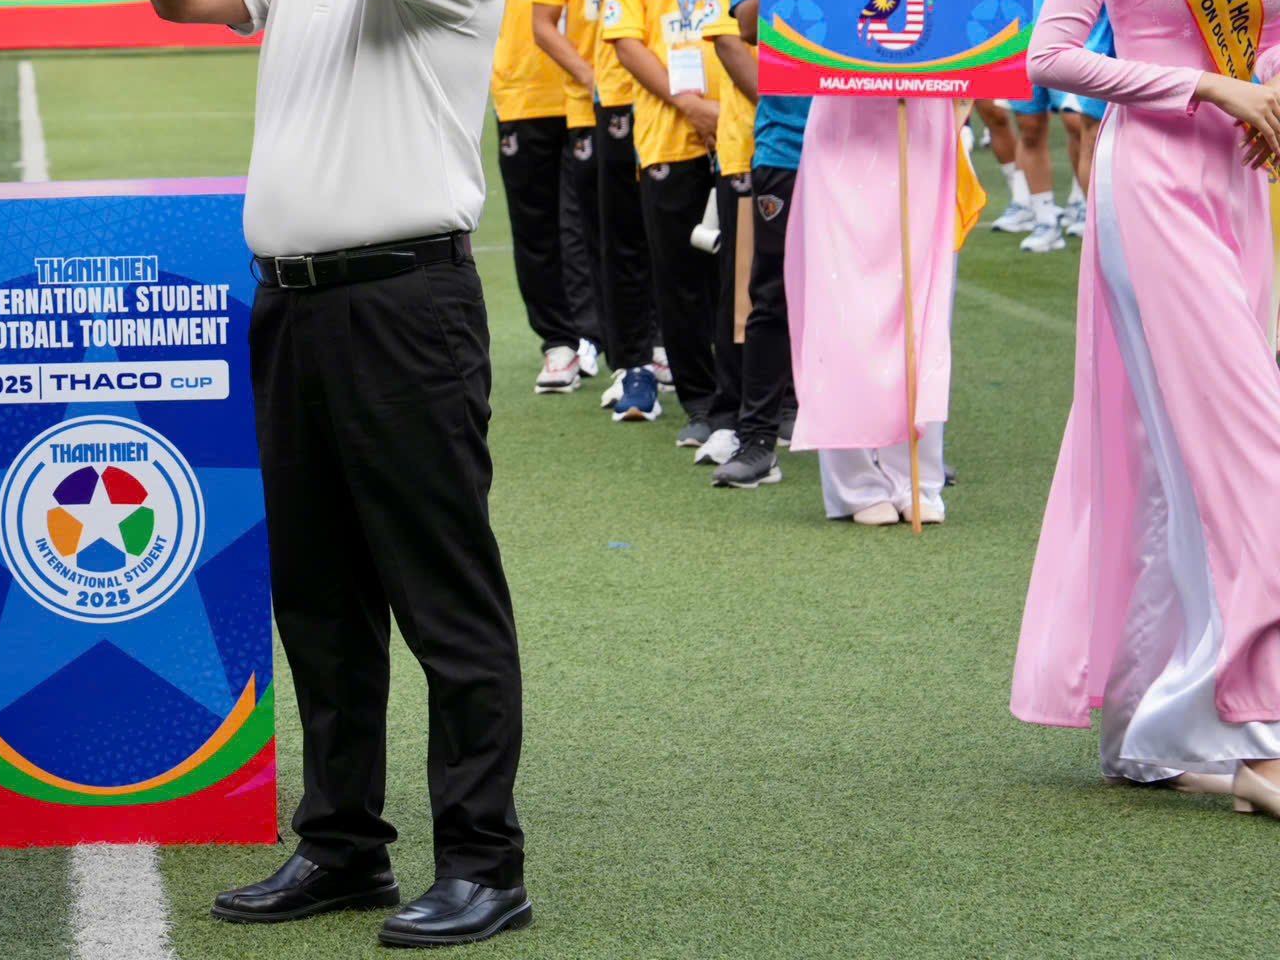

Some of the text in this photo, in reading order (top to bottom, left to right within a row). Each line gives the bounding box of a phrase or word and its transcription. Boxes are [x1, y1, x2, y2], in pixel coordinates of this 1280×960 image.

[1212, 25, 1229, 57] DUC
[819, 76, 969, 92] MALAYSIAN UNIVERSITY
[34, 257, 105, 285] THANH
[135, 284, 230, 313] STUDENT
[79, 317, 230, 348] TOURNAMENT
[49, 372, 162, 391] THACO
[170, 377, 213, 389] CUP
[50, 442, 108, 463] THANH
[35, 534, 168, 589] INTERNATIONAL STUDENT
[76, 589, 131, 608] 2025
